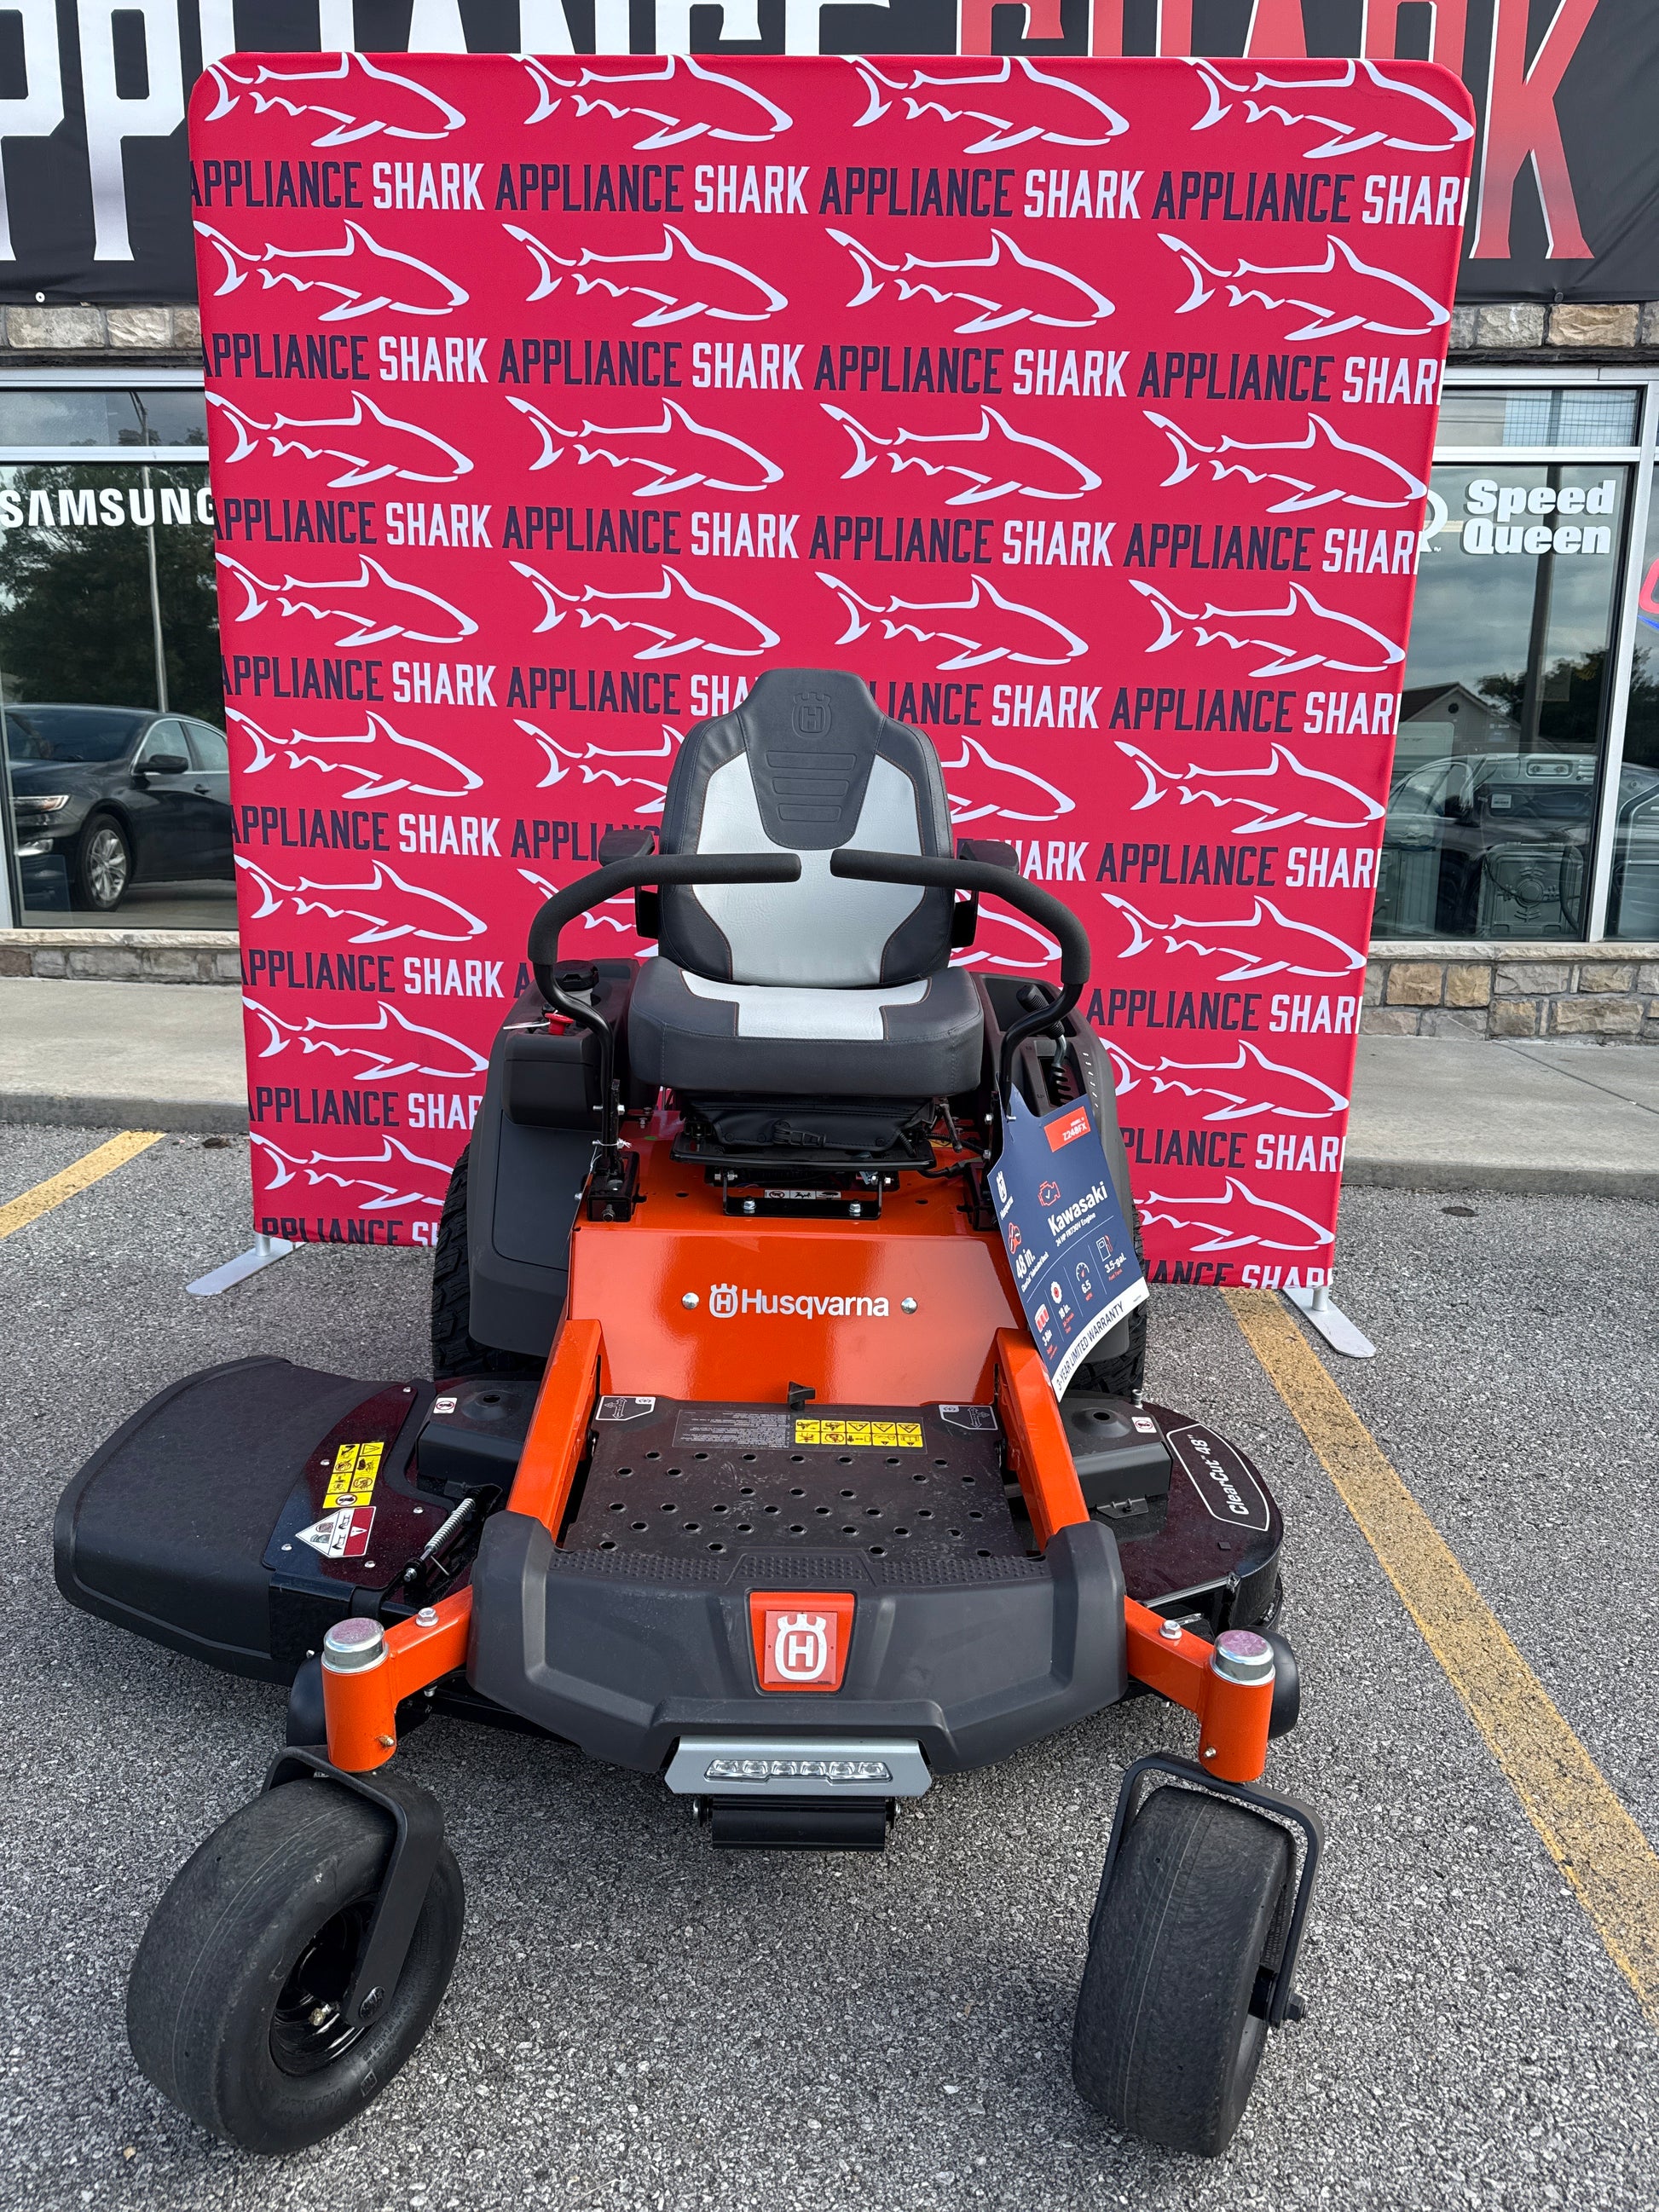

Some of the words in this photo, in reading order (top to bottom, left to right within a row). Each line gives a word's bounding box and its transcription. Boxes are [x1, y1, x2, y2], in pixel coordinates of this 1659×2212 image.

[373, 163, 484, 210] SHARK
[495, 164, 684, 212] APPLIANCE
[695, 165, 809, 213] SHARK
[819, 167, 1014, 217] APPLIANCE
[1025, 170, 1144, 218] SHARK
[1152, 171, 1355, 222] APPLIANCE
[379, 337, 488, 382] SHARK
[499, 339, 682, 387] APPLIANCE
[693, 343, 804, 390] SHARK
[814, 345, 1003, 394] APPLIANCE
[1014, 349, 1130, 396] SHARK
[1137, 352, 1334, 401] APPLIANCE
[1466, 479, 1617, 522] Speed
[386, 503, 492, 547] SHARK
[503, 506, 681, 554] APPLIANCE
[691, 512, 800, 558] SHARK
[809, 516, 993, 563] APPLIANCE
[1003, 521, 1116, 566] SHARK
[1124, 523, 1315, 571] APPLIANCE
[1463, 517, 1611, 554] Queen
[393, 661, 497, 706] SHARK
[507, 667, 680, 714] APPLIANCE
[691, 675, 753, 716] SHA
[870, 681, 983, 725] IANCE
[992, 685, 1101, 728] SHARK
[1109, 688, 1296, 732] APPLIANCE
[399, 814, 501, 857] SHARK
[511, 820, 660, 861] APPLI
[986, 839, 1089, 881] ARK
[1096, 843, 1278, 886] APPLIANCE
[404, 957, 504, 997] SHARK
[1087, 989, 1262, 1031] APPLIANCE
[1062, 1122, 1087, 1141] Z248FX
[1119, 1127, 1247, 1168] PLIANCE
[1048, 1181, 1107, 1236] Kawasaki
[1081, 1213, 1096, 1226] Engine
[1016, 1254, 1026, 1279] 48
[1081, 1279, 1091, 1294] 6.5
[1105, 1253, 1128, 1273] 3.5-gal.
[741, 1289, 889, 1320] Husqvarna
[1056, 1359, 1071, 1391] 3-YEAR
[1070, 1337, 1090, 1366] LIMITED
[1087, 1301, 1124, 1343] WARRANTY
[1204, 1458, 1250, 1516] ClearCut
